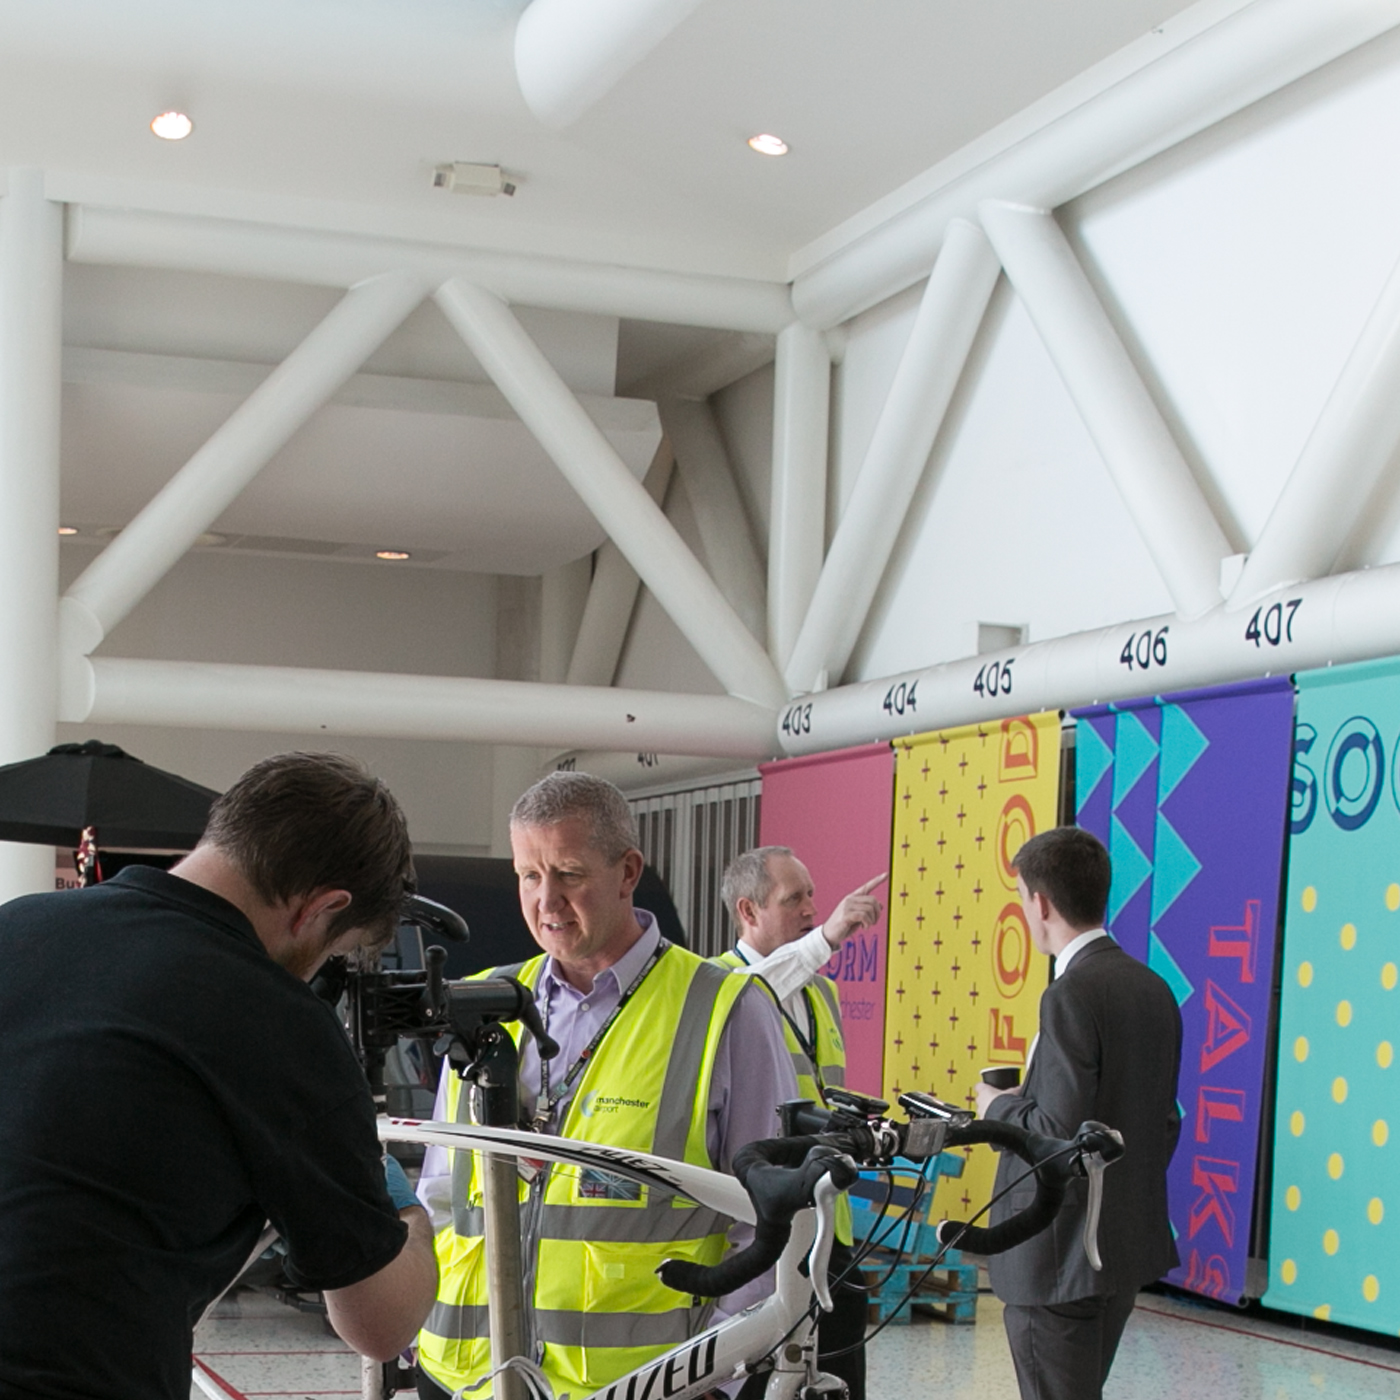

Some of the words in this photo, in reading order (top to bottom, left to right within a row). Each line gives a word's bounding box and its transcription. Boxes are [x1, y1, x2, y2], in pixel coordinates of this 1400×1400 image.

[1245, 598, 1303, 648] 407
[1120, 626, 1170, 671] 406
[883, 679, 919, 716] 404
[973, 657, 1013, 699] 405
[781, 702, 813, 736] 403
[595, 1096, 651, 1109] manchester
